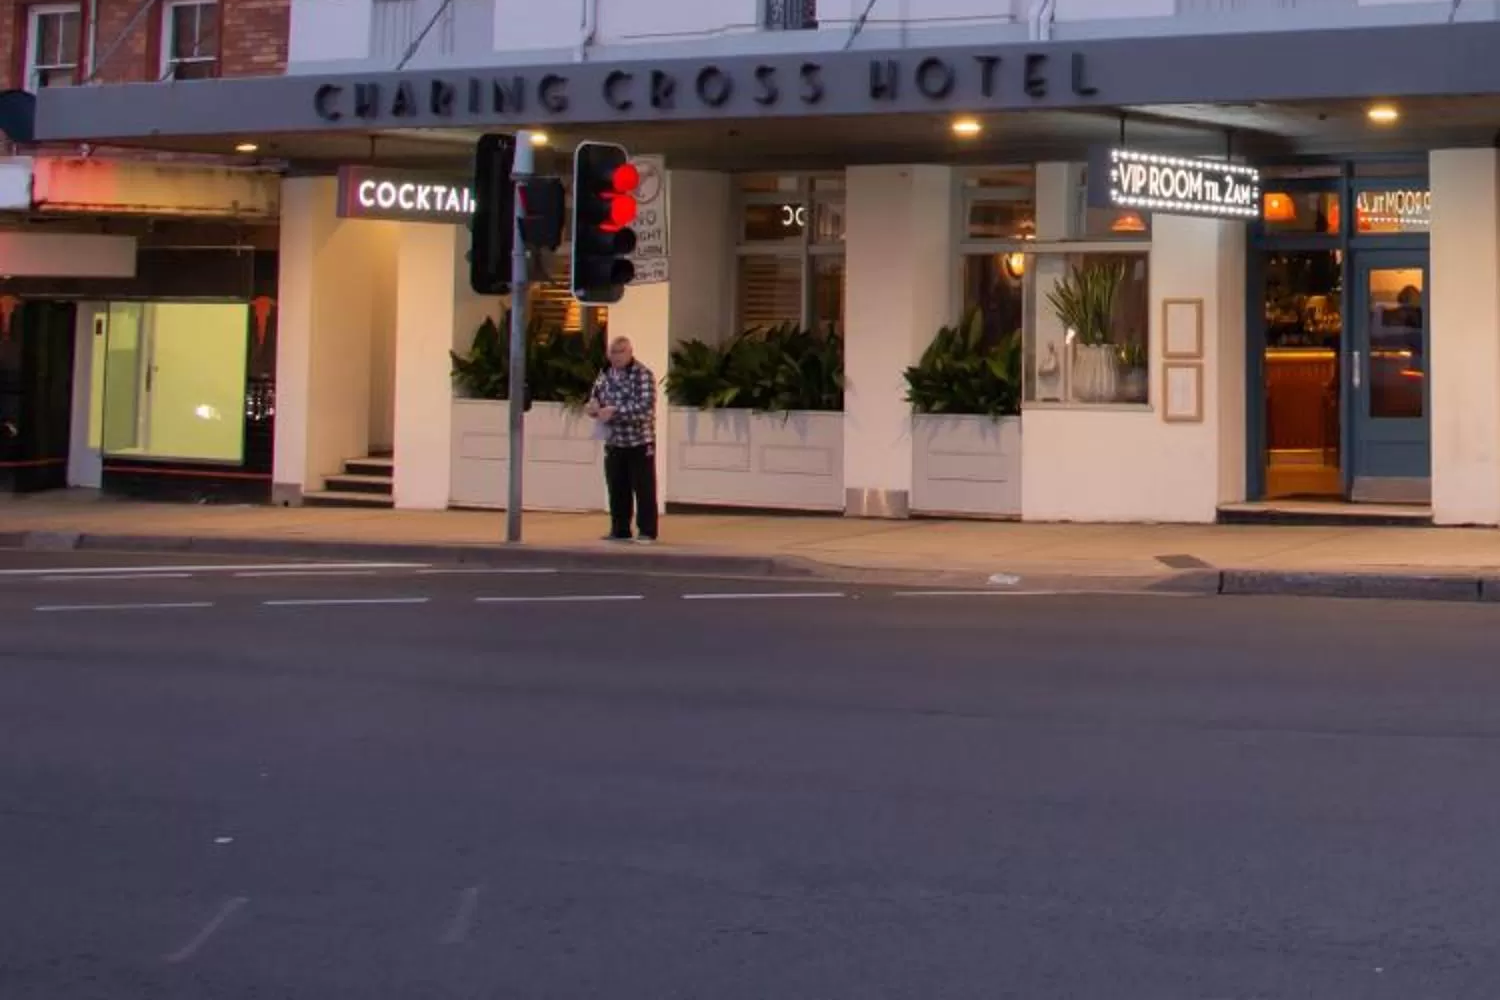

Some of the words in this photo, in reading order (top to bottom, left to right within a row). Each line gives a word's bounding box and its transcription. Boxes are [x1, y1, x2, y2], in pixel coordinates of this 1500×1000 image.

[314, 74, 569, 121] CHARING
[603, 64, 826, 111] CROSS
[868, 53, 1100, 99] HOTEL
[1119, 162, 1146, 194] VIP
[1149, 166, 1203, 200] ROOM
[1204, 181, 1221, 202] TIL
[1224, 175, 1251, 205] 2AM
